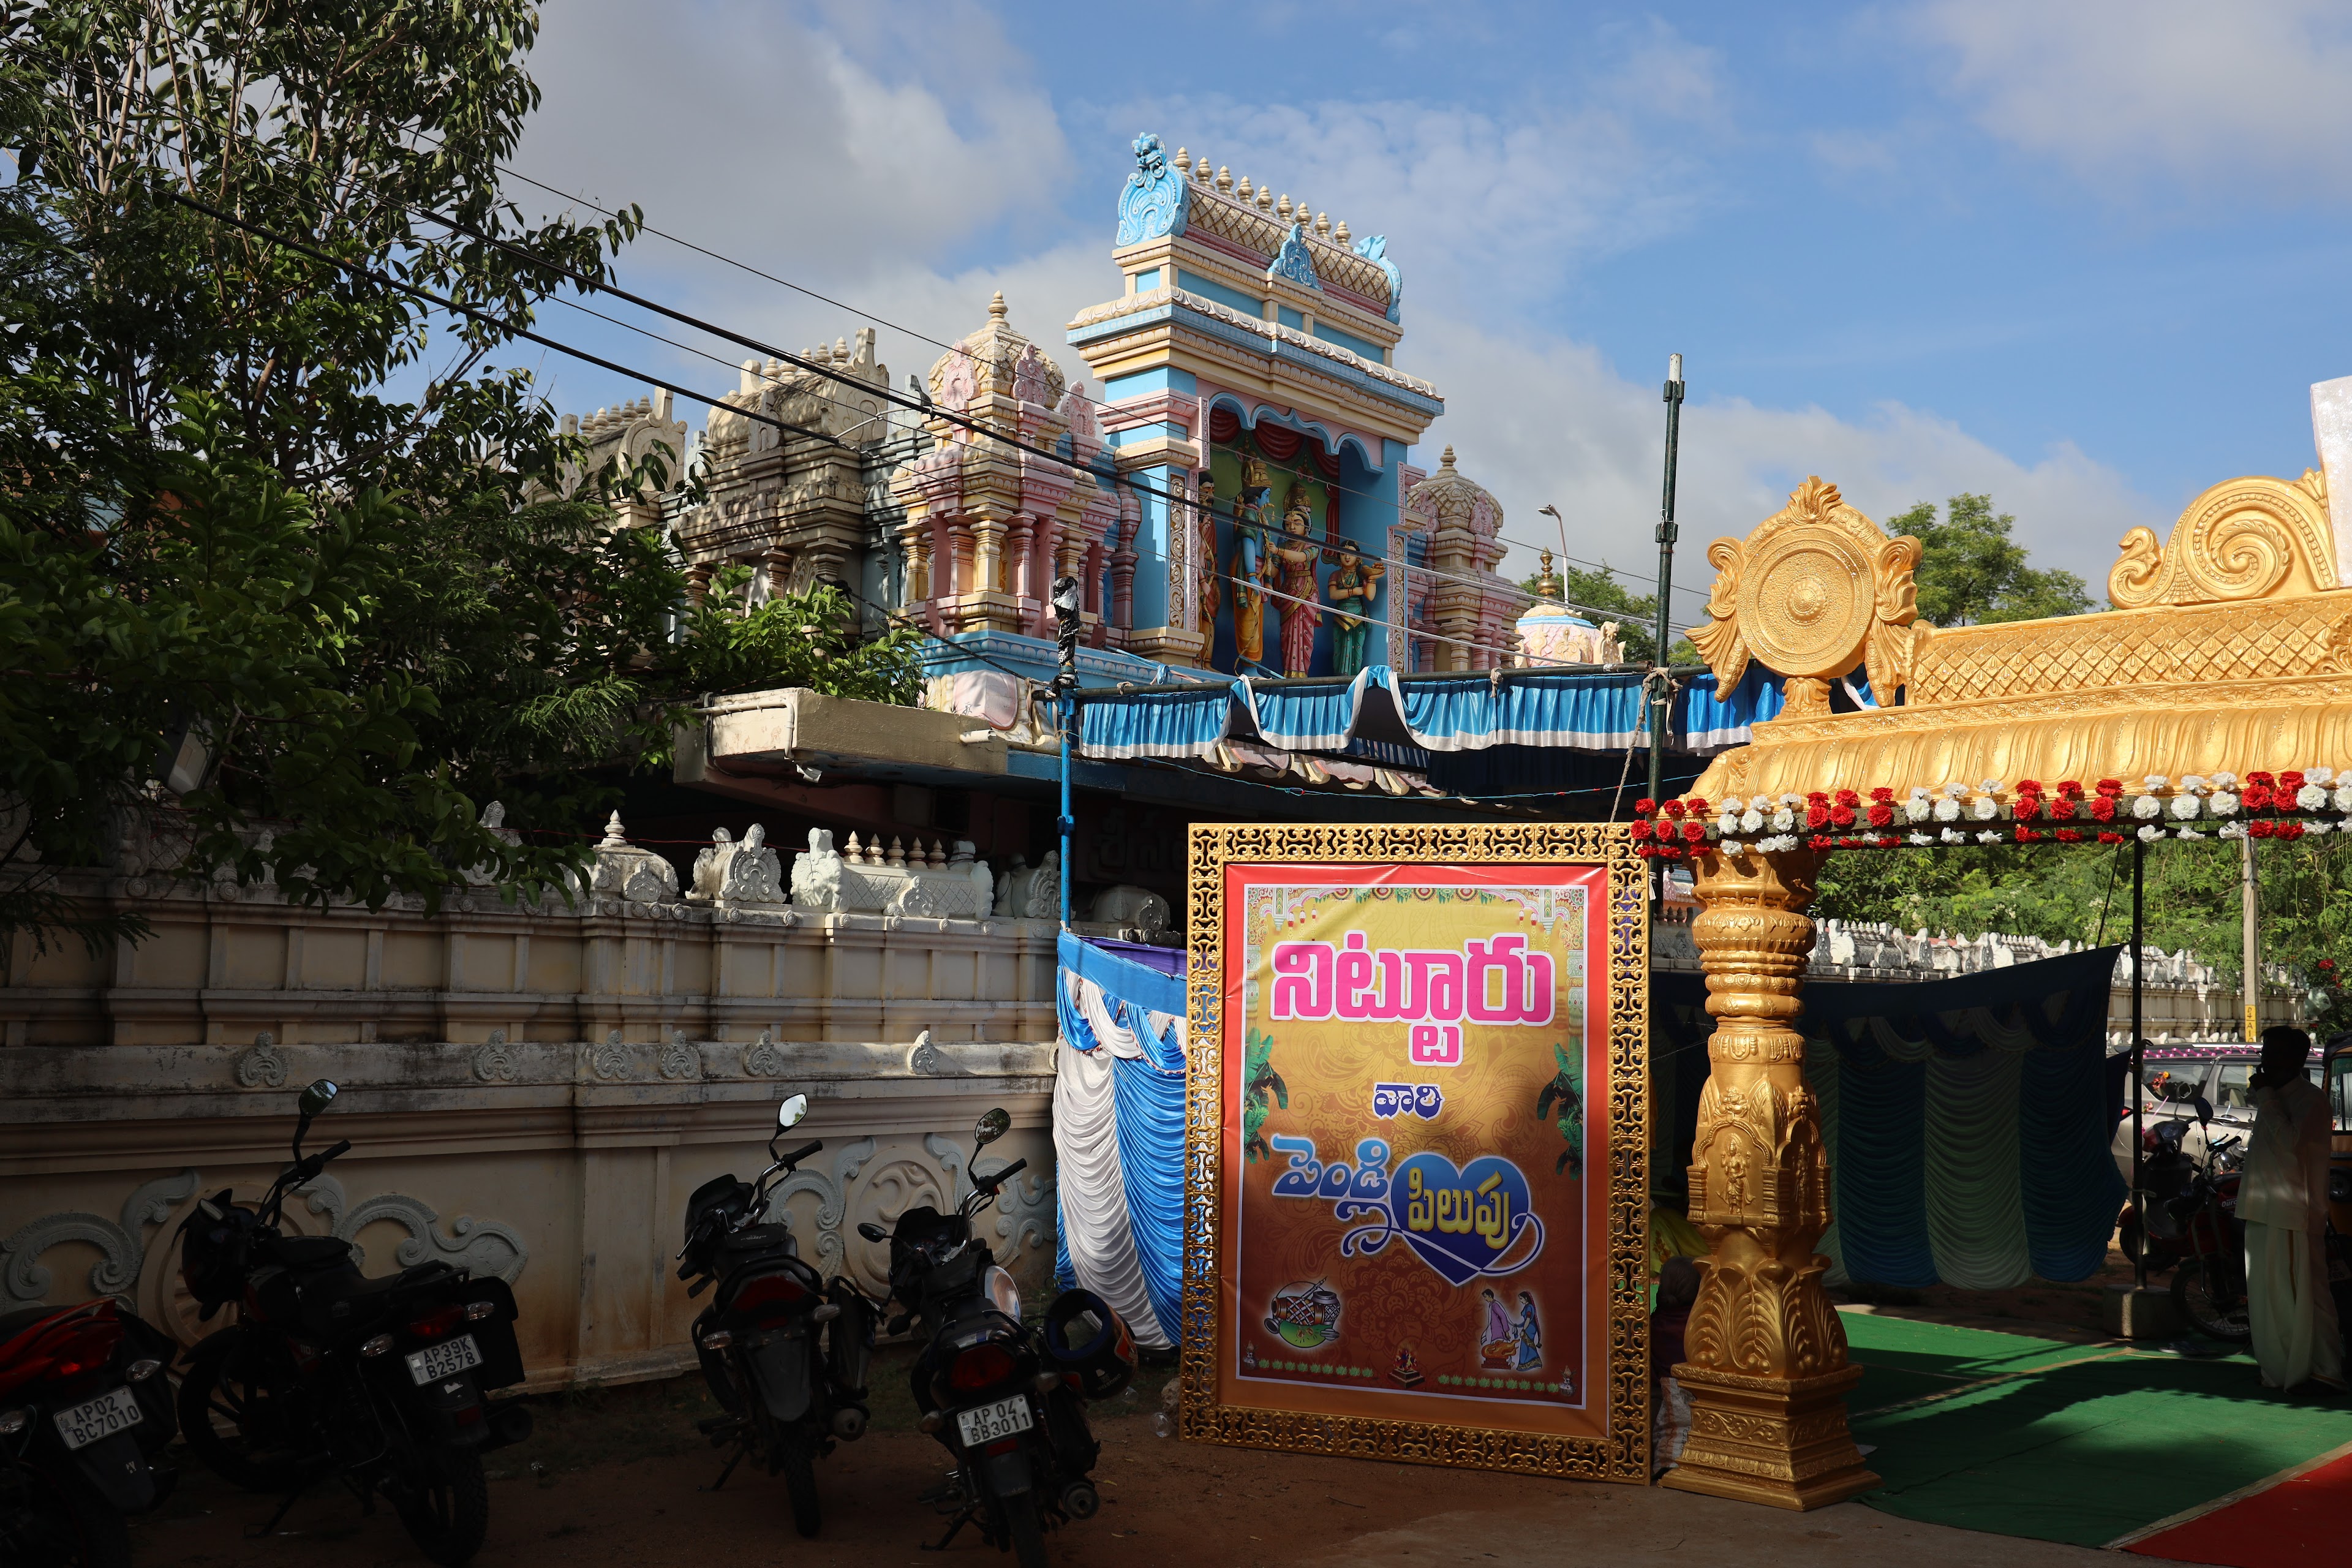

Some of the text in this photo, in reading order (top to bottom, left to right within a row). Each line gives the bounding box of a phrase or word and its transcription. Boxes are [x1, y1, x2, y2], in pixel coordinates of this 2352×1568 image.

[1272, 932, 1553, 1065] నిట్టూరు
[1373, 1083, 1444, 1120] వారి
[1271, 1133, 1510, 1255] పెండ్లి పిలుపు
[423, 1337, 471, 1365] AP39K
[426, 1352, 475, 1379] B2578
[73, 1405, 139, 1444] BC7010
[74, 1396, 119, 1425] AP02
[974, 1400, 1016, 1427] AP 04
